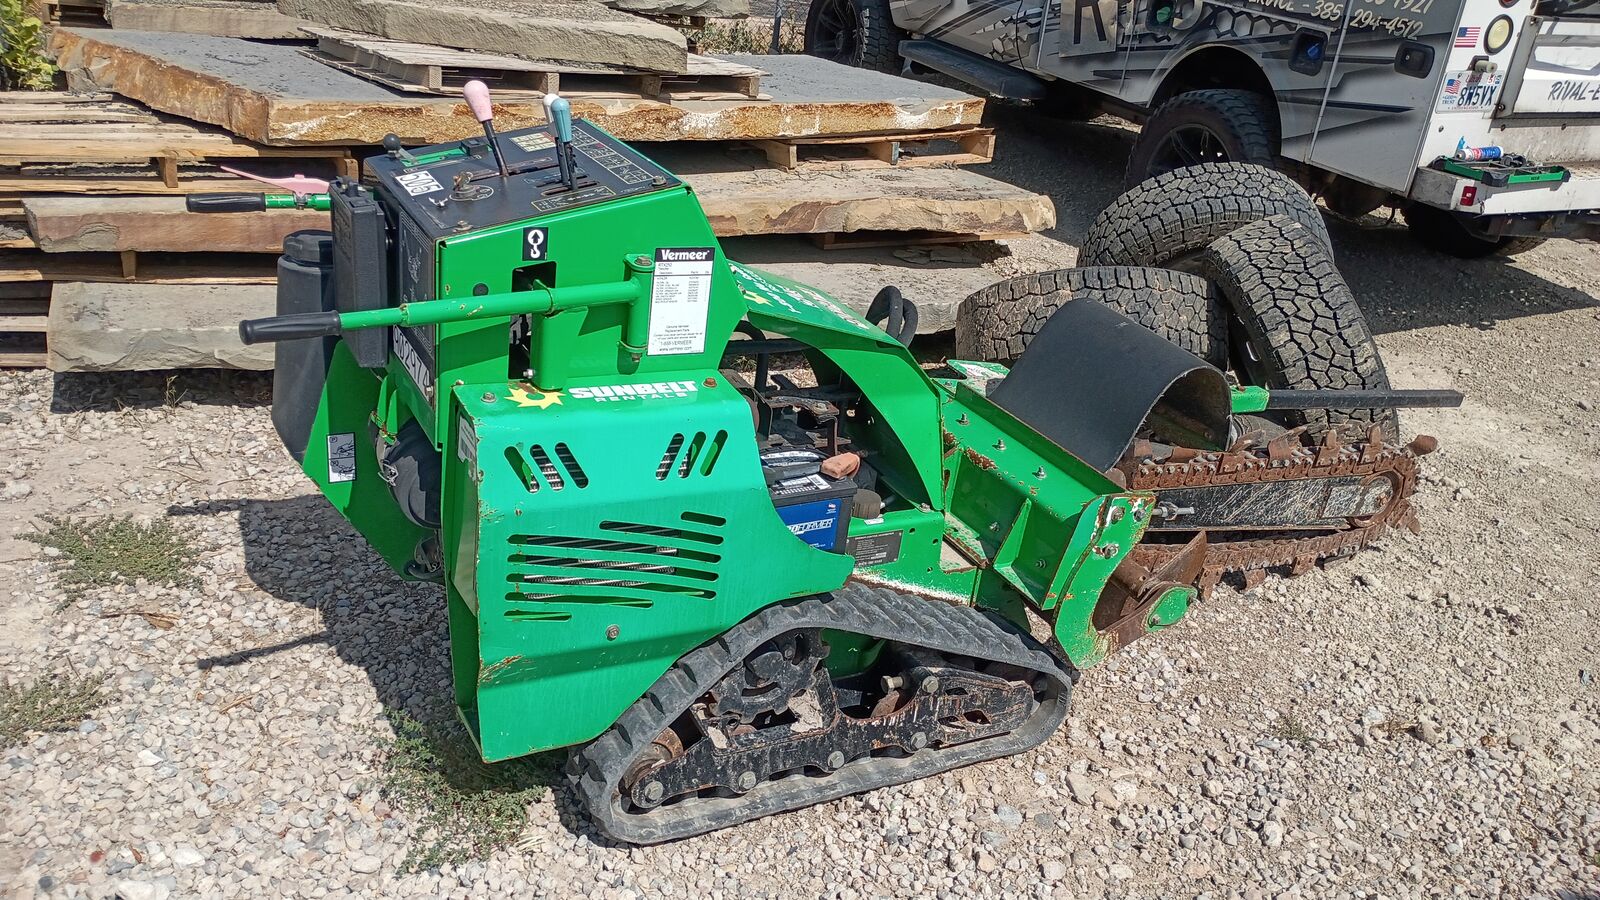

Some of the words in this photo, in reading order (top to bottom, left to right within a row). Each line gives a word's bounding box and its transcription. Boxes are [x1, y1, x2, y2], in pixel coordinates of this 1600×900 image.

[1350, 9, 1424, 40] 294-4512
[1458, 86, 1497, 106] 8W5VX
[661, 249, 707, 260] Vermeer
[568, 381, 699, 399] SUNBELT
[594, 391, 689, 402] RENTALS
